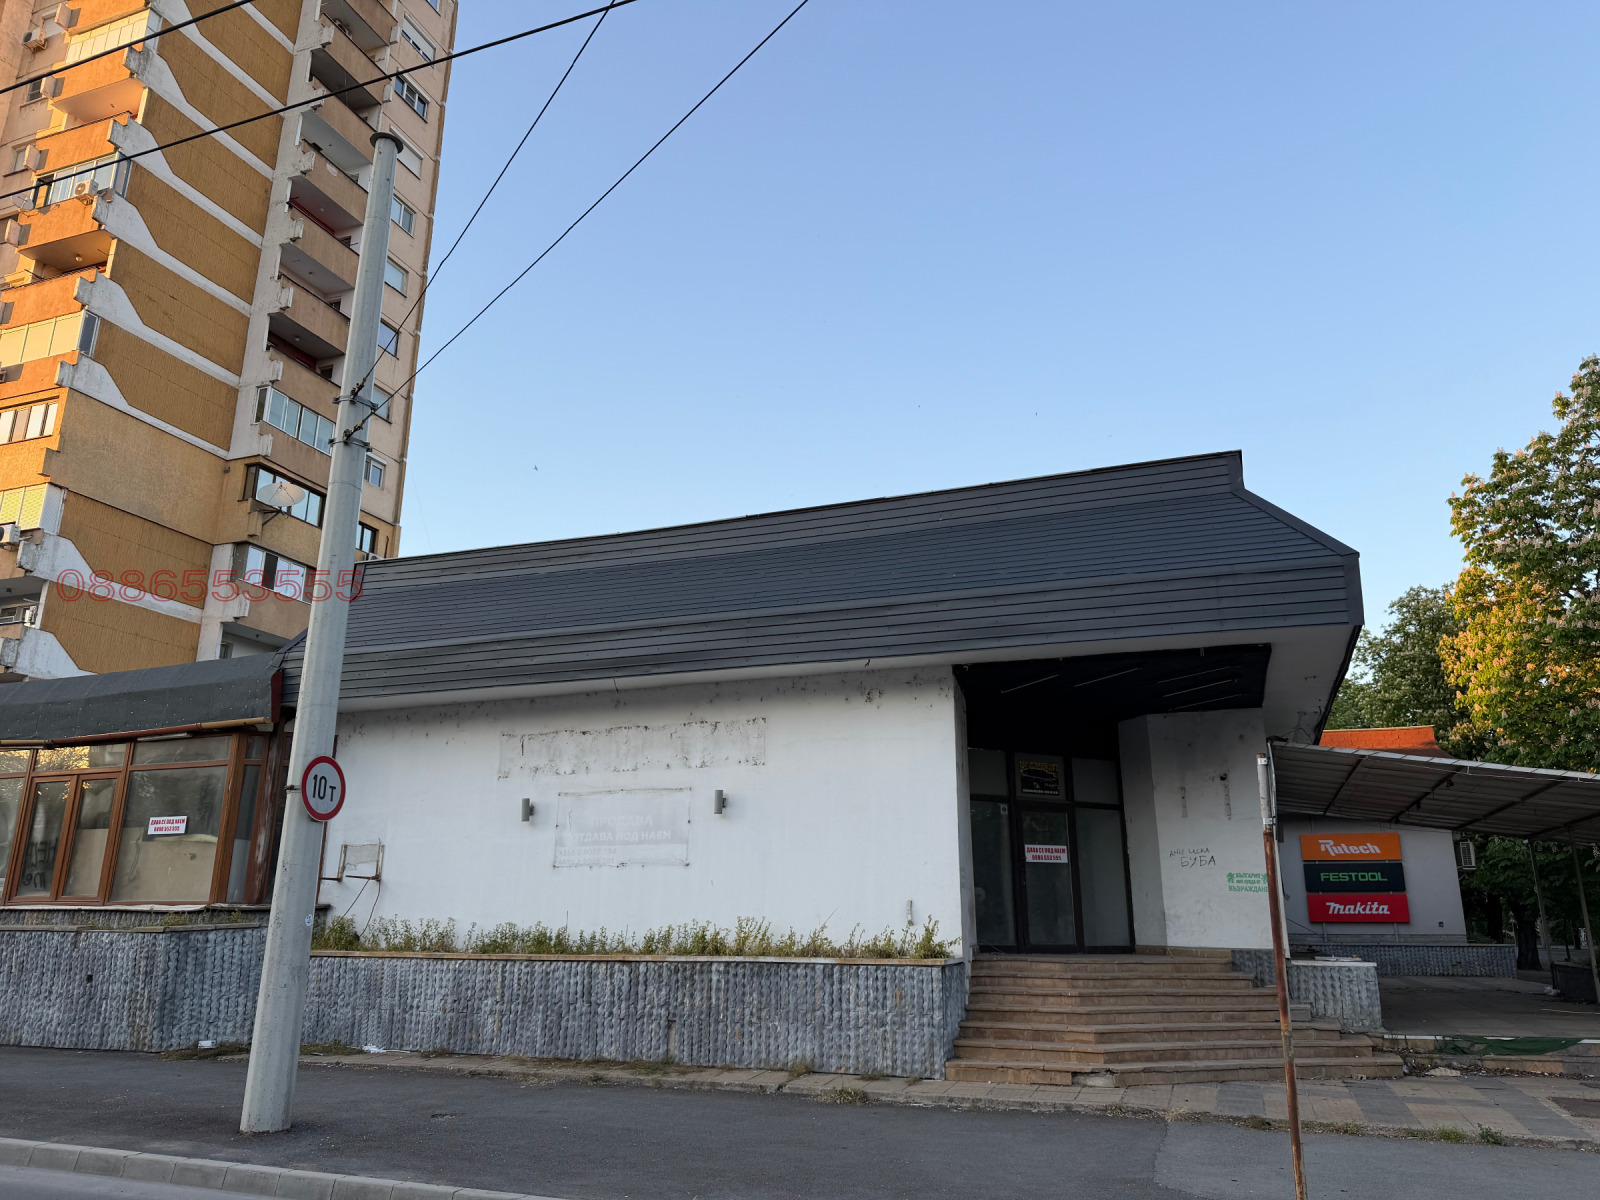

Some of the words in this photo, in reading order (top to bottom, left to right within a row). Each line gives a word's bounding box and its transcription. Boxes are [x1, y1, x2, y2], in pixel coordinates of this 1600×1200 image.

[616, 831, 639, 842] ПОД
[641, 830, 672, 840] НАЕМ
[1318, 839, 1381, 856] Rutech
[1181, 855, 1216, 868] БУБА
[1320, 872, 1388, 882] FESTOOL
